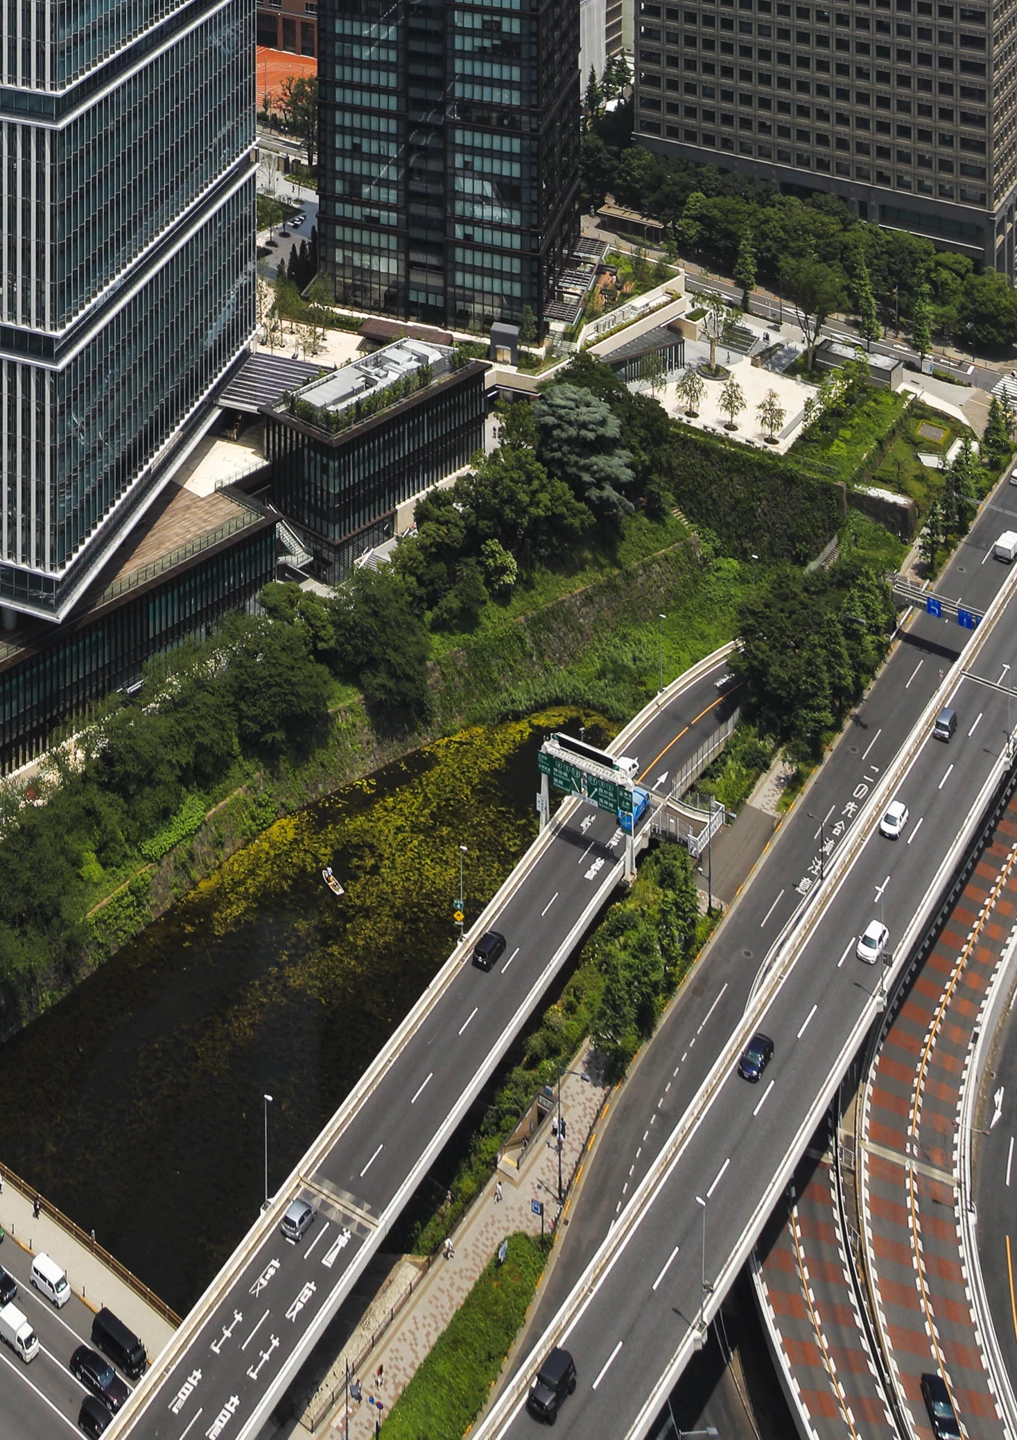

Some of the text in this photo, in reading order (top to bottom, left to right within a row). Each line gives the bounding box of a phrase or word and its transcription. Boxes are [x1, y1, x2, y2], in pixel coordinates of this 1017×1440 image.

[795, 765, 879, 896] この先合流注意
[168, 1237, 296, 1415] 度注意
